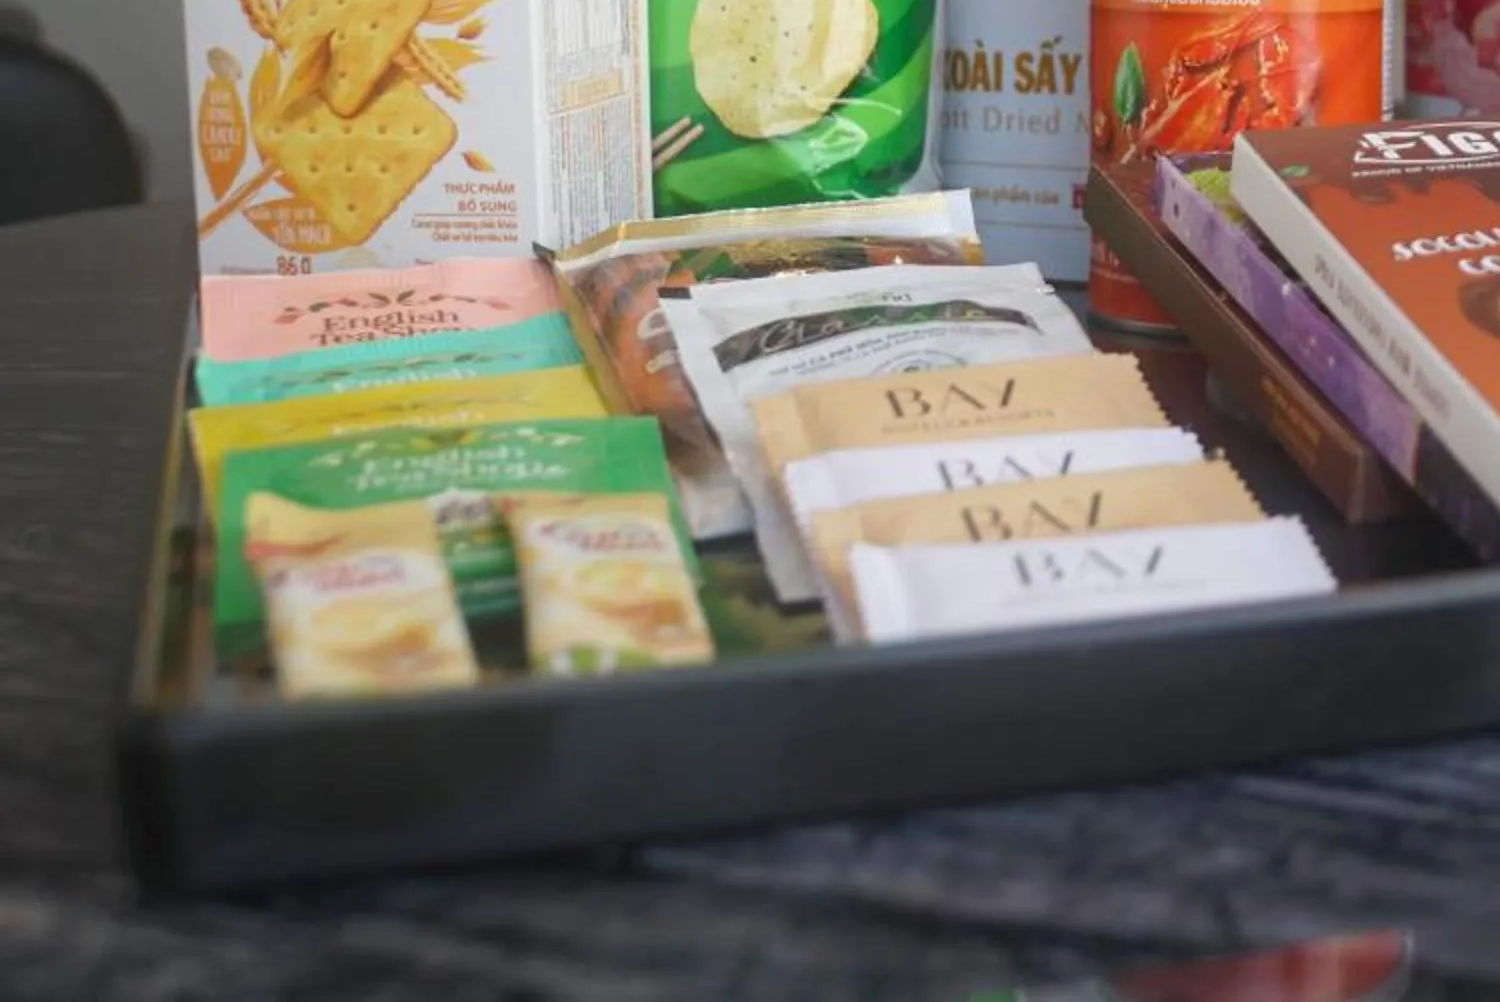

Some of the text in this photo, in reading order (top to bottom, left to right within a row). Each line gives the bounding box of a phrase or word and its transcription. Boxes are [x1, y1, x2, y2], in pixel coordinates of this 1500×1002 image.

[1014, 35, 1083, 95] SẤY
[983, 106, 1061, 135] Dried
[321, 309, 460, 332] English
